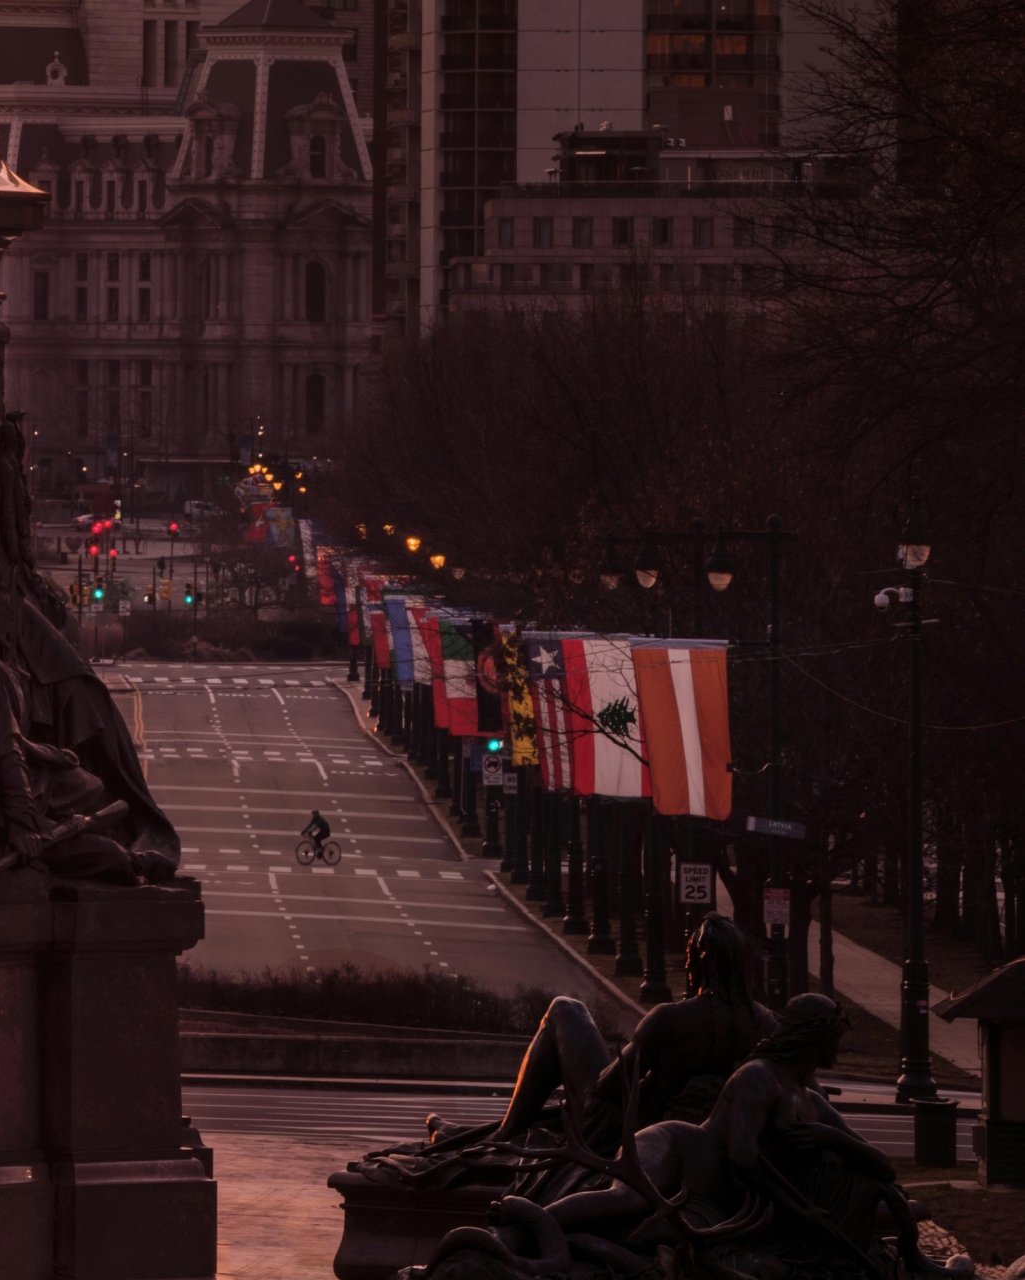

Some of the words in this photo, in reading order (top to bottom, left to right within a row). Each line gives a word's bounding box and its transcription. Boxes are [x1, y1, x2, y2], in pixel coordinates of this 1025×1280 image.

[769, 821, 792, 829] LATVIA
[683, 866, 709, 875] SPEED
[685, 884, 707, 900] 25
